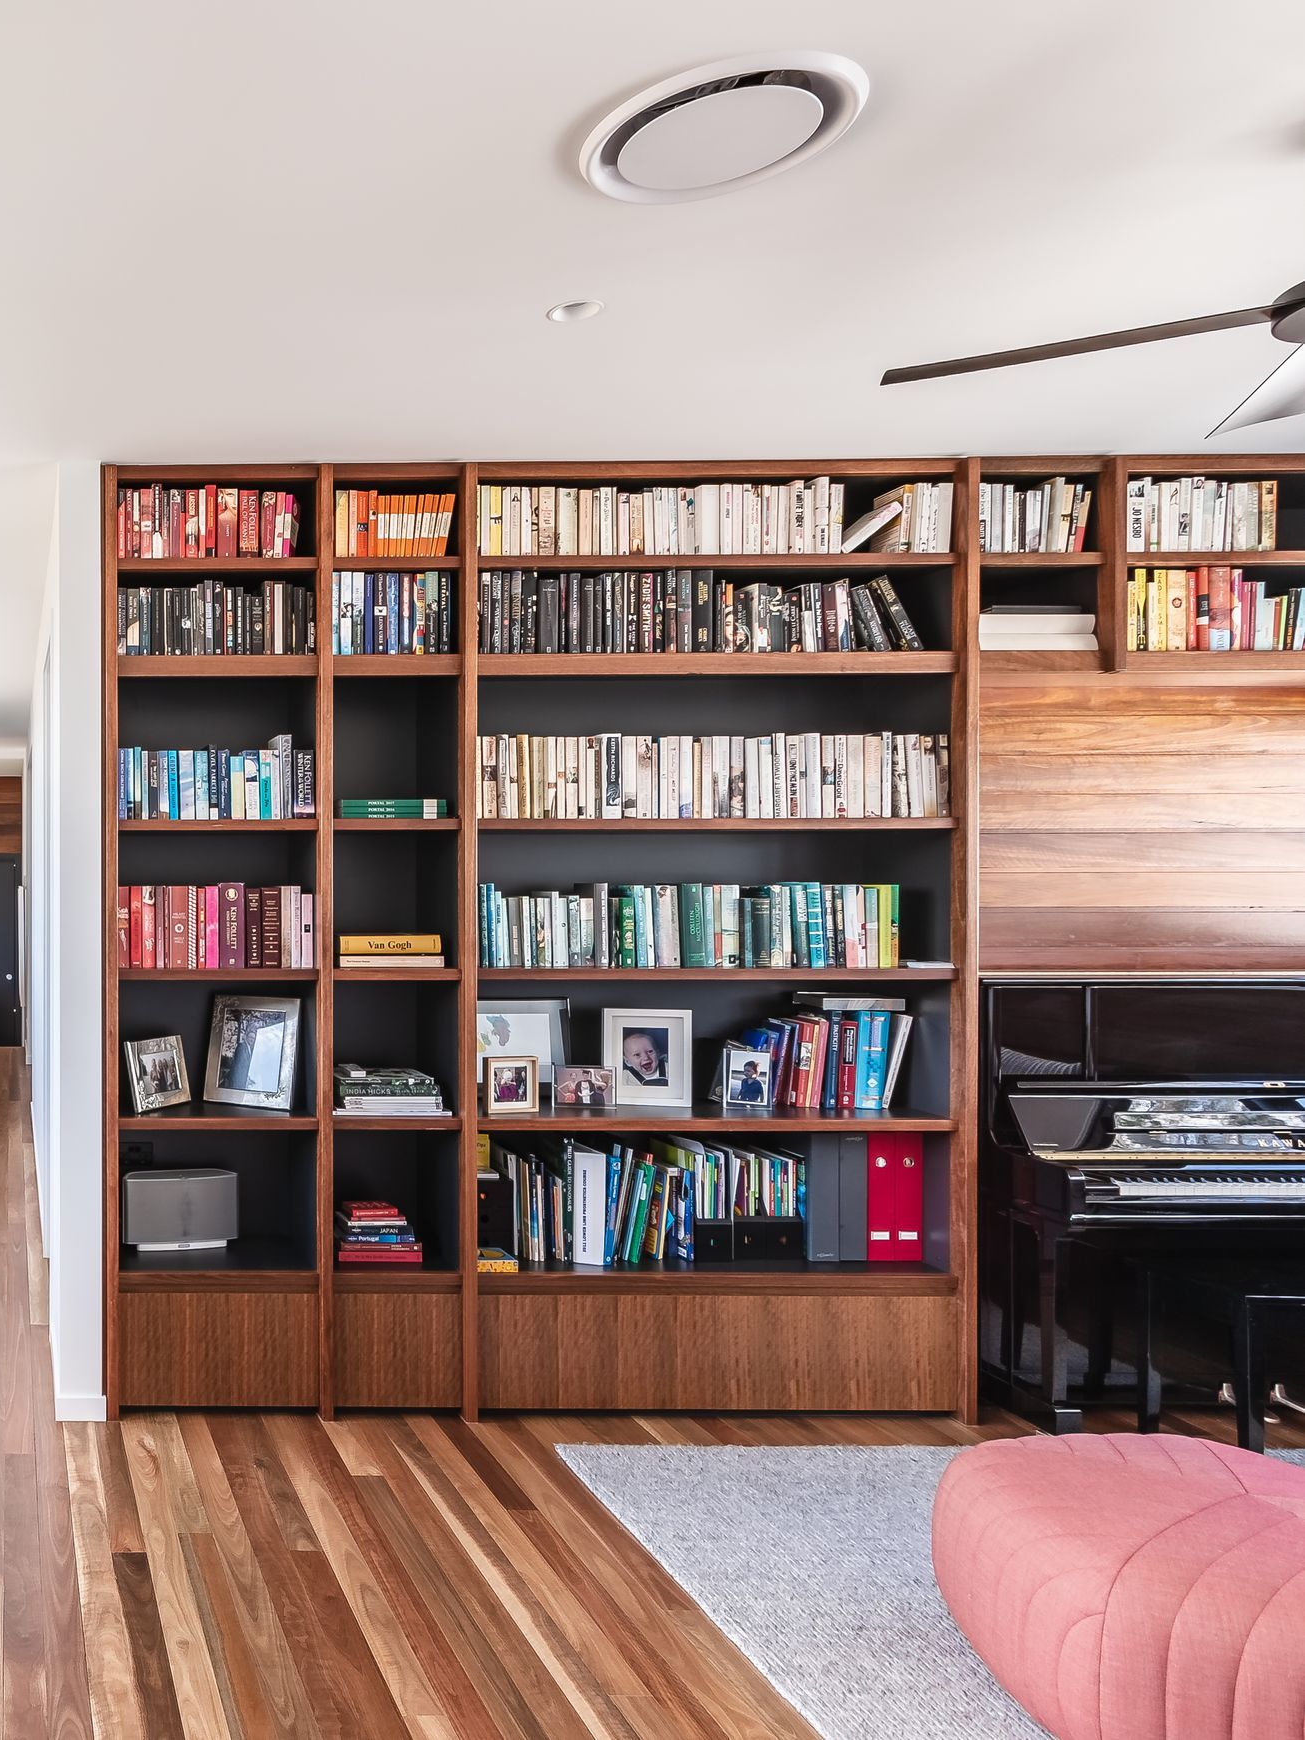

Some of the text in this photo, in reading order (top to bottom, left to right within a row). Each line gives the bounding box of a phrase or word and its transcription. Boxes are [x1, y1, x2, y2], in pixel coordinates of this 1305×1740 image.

[242, 511, 248, 521] OF
[248, 496, 257, 545] KEN FOLLETT
[795, 511, 804, 529] TIGER
[1132, 507, 1142, 517] JO
[980, 538, 986, 546] le
[511, 592, 520, 620] KENEALLY
[642, 578, 651, 631] ZADIE SMITH
[898, 620, 912, 641] TUDOR
[906, 624, 917, 639] LAST
[304, 755, 312, 805] KEN FOLLETT
[789, 760, 797, 782] ENGLAND
[297, 783, 305, 807] WORLD
[836, 780, 844, 799] Grohl
[230, 922, 238, 950] FOLLETT
[368, 940, 412, 951] Van Gogh
[781, 1030, 790, 1057] EXAMINATION
[367, 1088, 391, 1096] HICKS
[358, 1235, 380, 1243] Portugal
